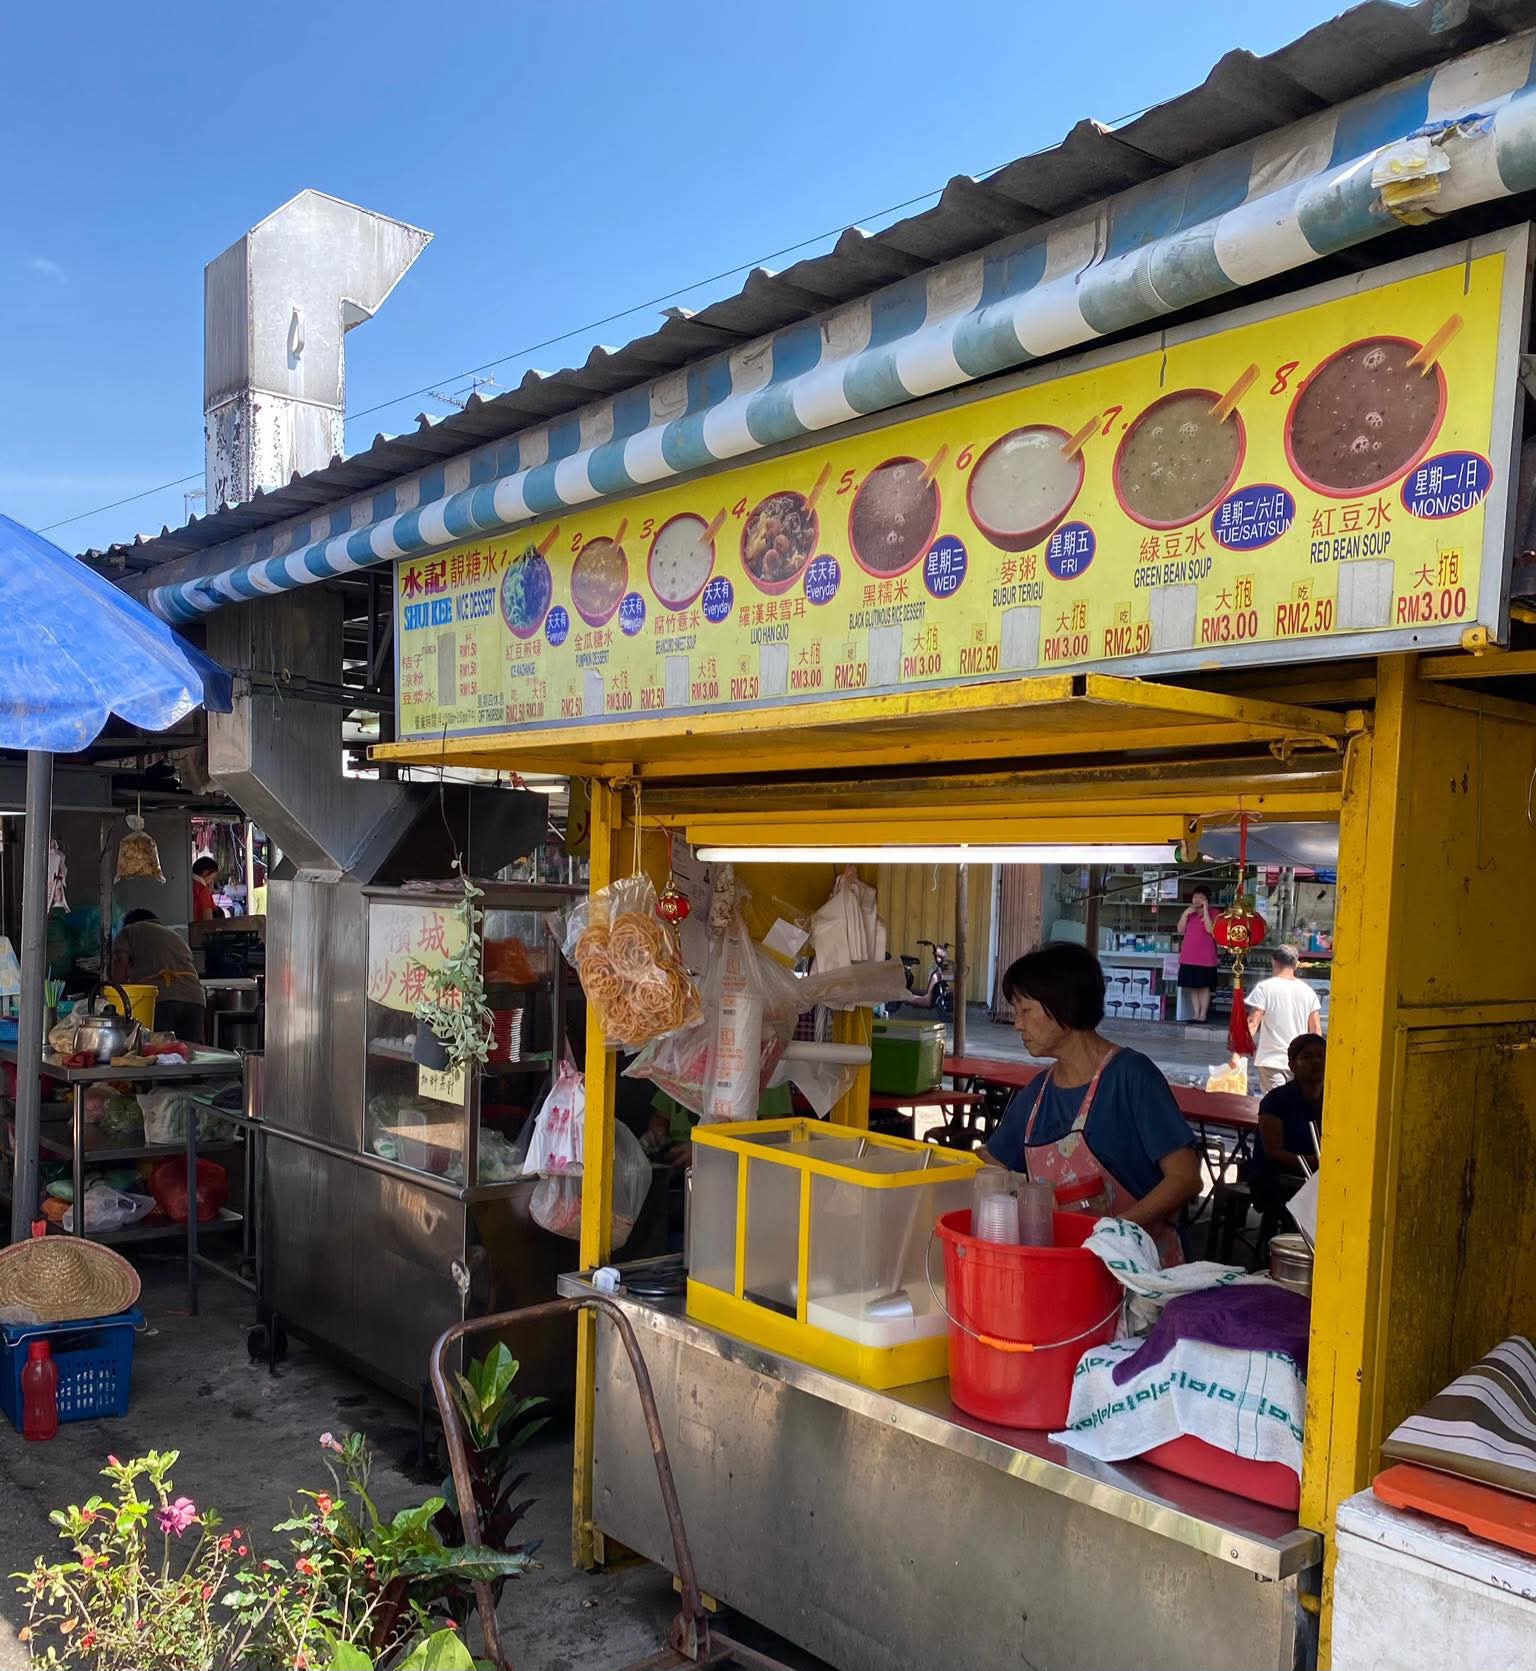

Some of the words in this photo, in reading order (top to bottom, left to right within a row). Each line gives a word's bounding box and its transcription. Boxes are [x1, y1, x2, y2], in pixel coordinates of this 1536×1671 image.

[1102, 405, 1129, 436] 7.
[837, 469, 858, 494] 5.
[1415, 460, 1477, 496] 星期一/日
[732, 497, 750, 519] 4.
[1221, 493, 1285, 527] 星期二/六/日
[1411, 489, 1484, 517] MON/SUN
[1216, 517, 1295, 544] TUE/SAT/SUN
[1311, 497, 1392, 538] 紅豆水
[1051, 530, 1089, 558] 星期五
[1139, 527, 1206, 563] 綠豆水
[1310, 540, 1330, 564] RED
[1333, 536, 1360, 561] BEAN
[1362, 531, 1391, 557] SOUP
[451, 545, 497, 589] 靚糖水
[808, 559, 836, 583] 天天有
[928, 548, 963, 576] 星期三
[1061, 559, 1078, 574] FRI
[1134, 565, 1161, 589] GREEN
[1163, 561, 1187, 584] BEAN
[1188, 557, 1212, 580] SOUP
[401, 560, 448, 599] 水記
[705, 579, 730, 601] 天天有
[806, 582, 839, 600] Everyday
[863, 578, 909, 607] 黑糯米
[933, 575, 957, 592] WED
[1298, 586, 1308, 600] 吃
[456, 594, 469, 621] NICE
[470, 587, 496, 619] DESSERT
[621, 596, 643, 616] 天天有
[992, 587, 1016, 607] BUBUR
[1018, 581, 1044, 604] TERIGU
[404, 602, 430, 630] SHUI
[431, 597, 453, 625] KEE
[704, 601, 732, 618] Everyday
[739, 597, 807, 628] 羅漢果雪耳
[849, 612, 865, 630] BLACK
[891, 604, 903, 623] RICE
[903, 601, 926, 621] DESSERT
[1276, 599, 1333, 635] RM2.50
[751, 627, 763, 645] LUO
[763, 624, 775, 642] HAN
[776, 623, 790, 641] GUO
[1104, 623, 1151, 657] RM2.50
[960, 645, 998, 674] RM2.50
[730, 676, 758, 700] RM2.50
[835, 663, 867, 688] RM2.50
[640, 688, 665, 709] RM2.50
